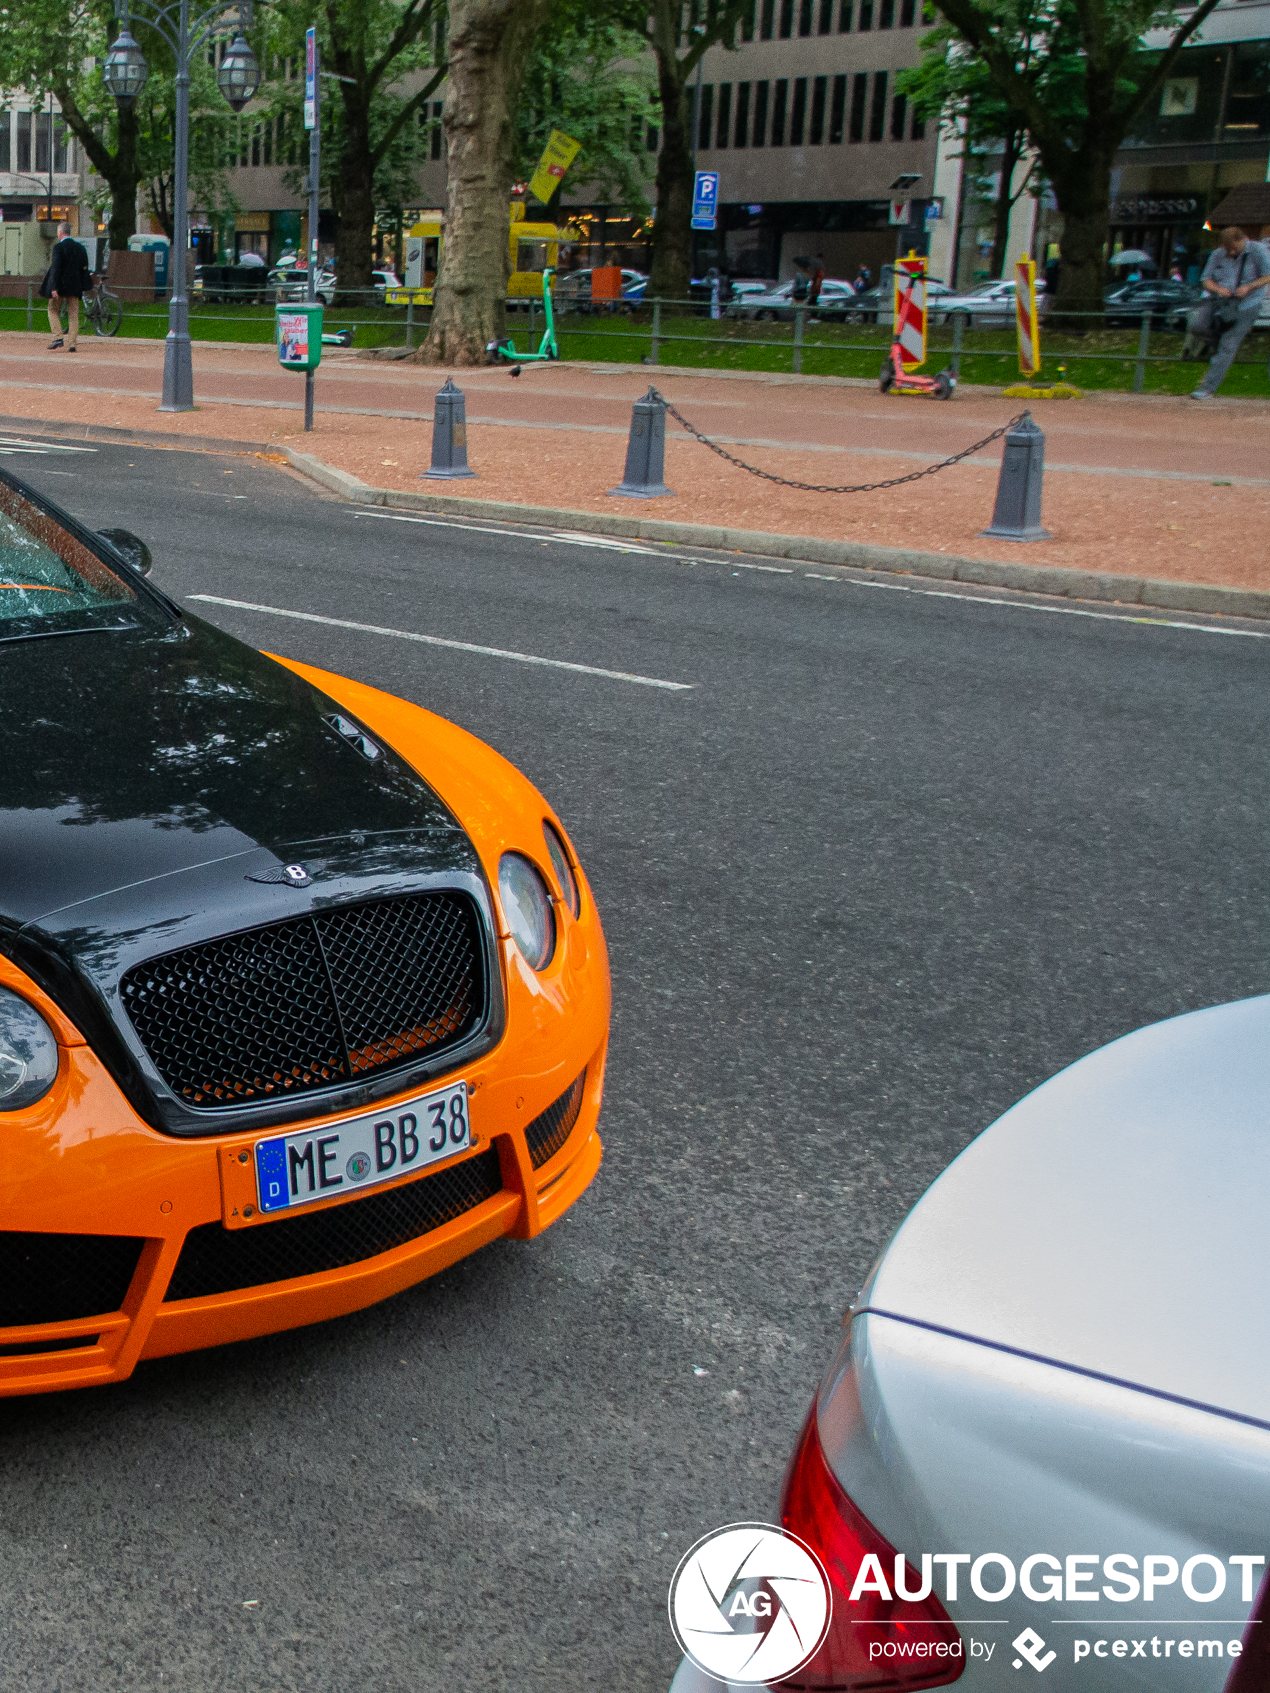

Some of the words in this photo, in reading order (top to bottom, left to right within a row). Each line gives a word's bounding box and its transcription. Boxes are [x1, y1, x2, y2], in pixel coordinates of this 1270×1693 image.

[701, 181, 714, 198] P
[286, 864, 307, 880] B
[269, 1181, 280, 1198] D
[288, 1134, 343, 1196] ME
[374, 1113, 419, 1173] BB
[428, 1093, 467, 1153] 38
